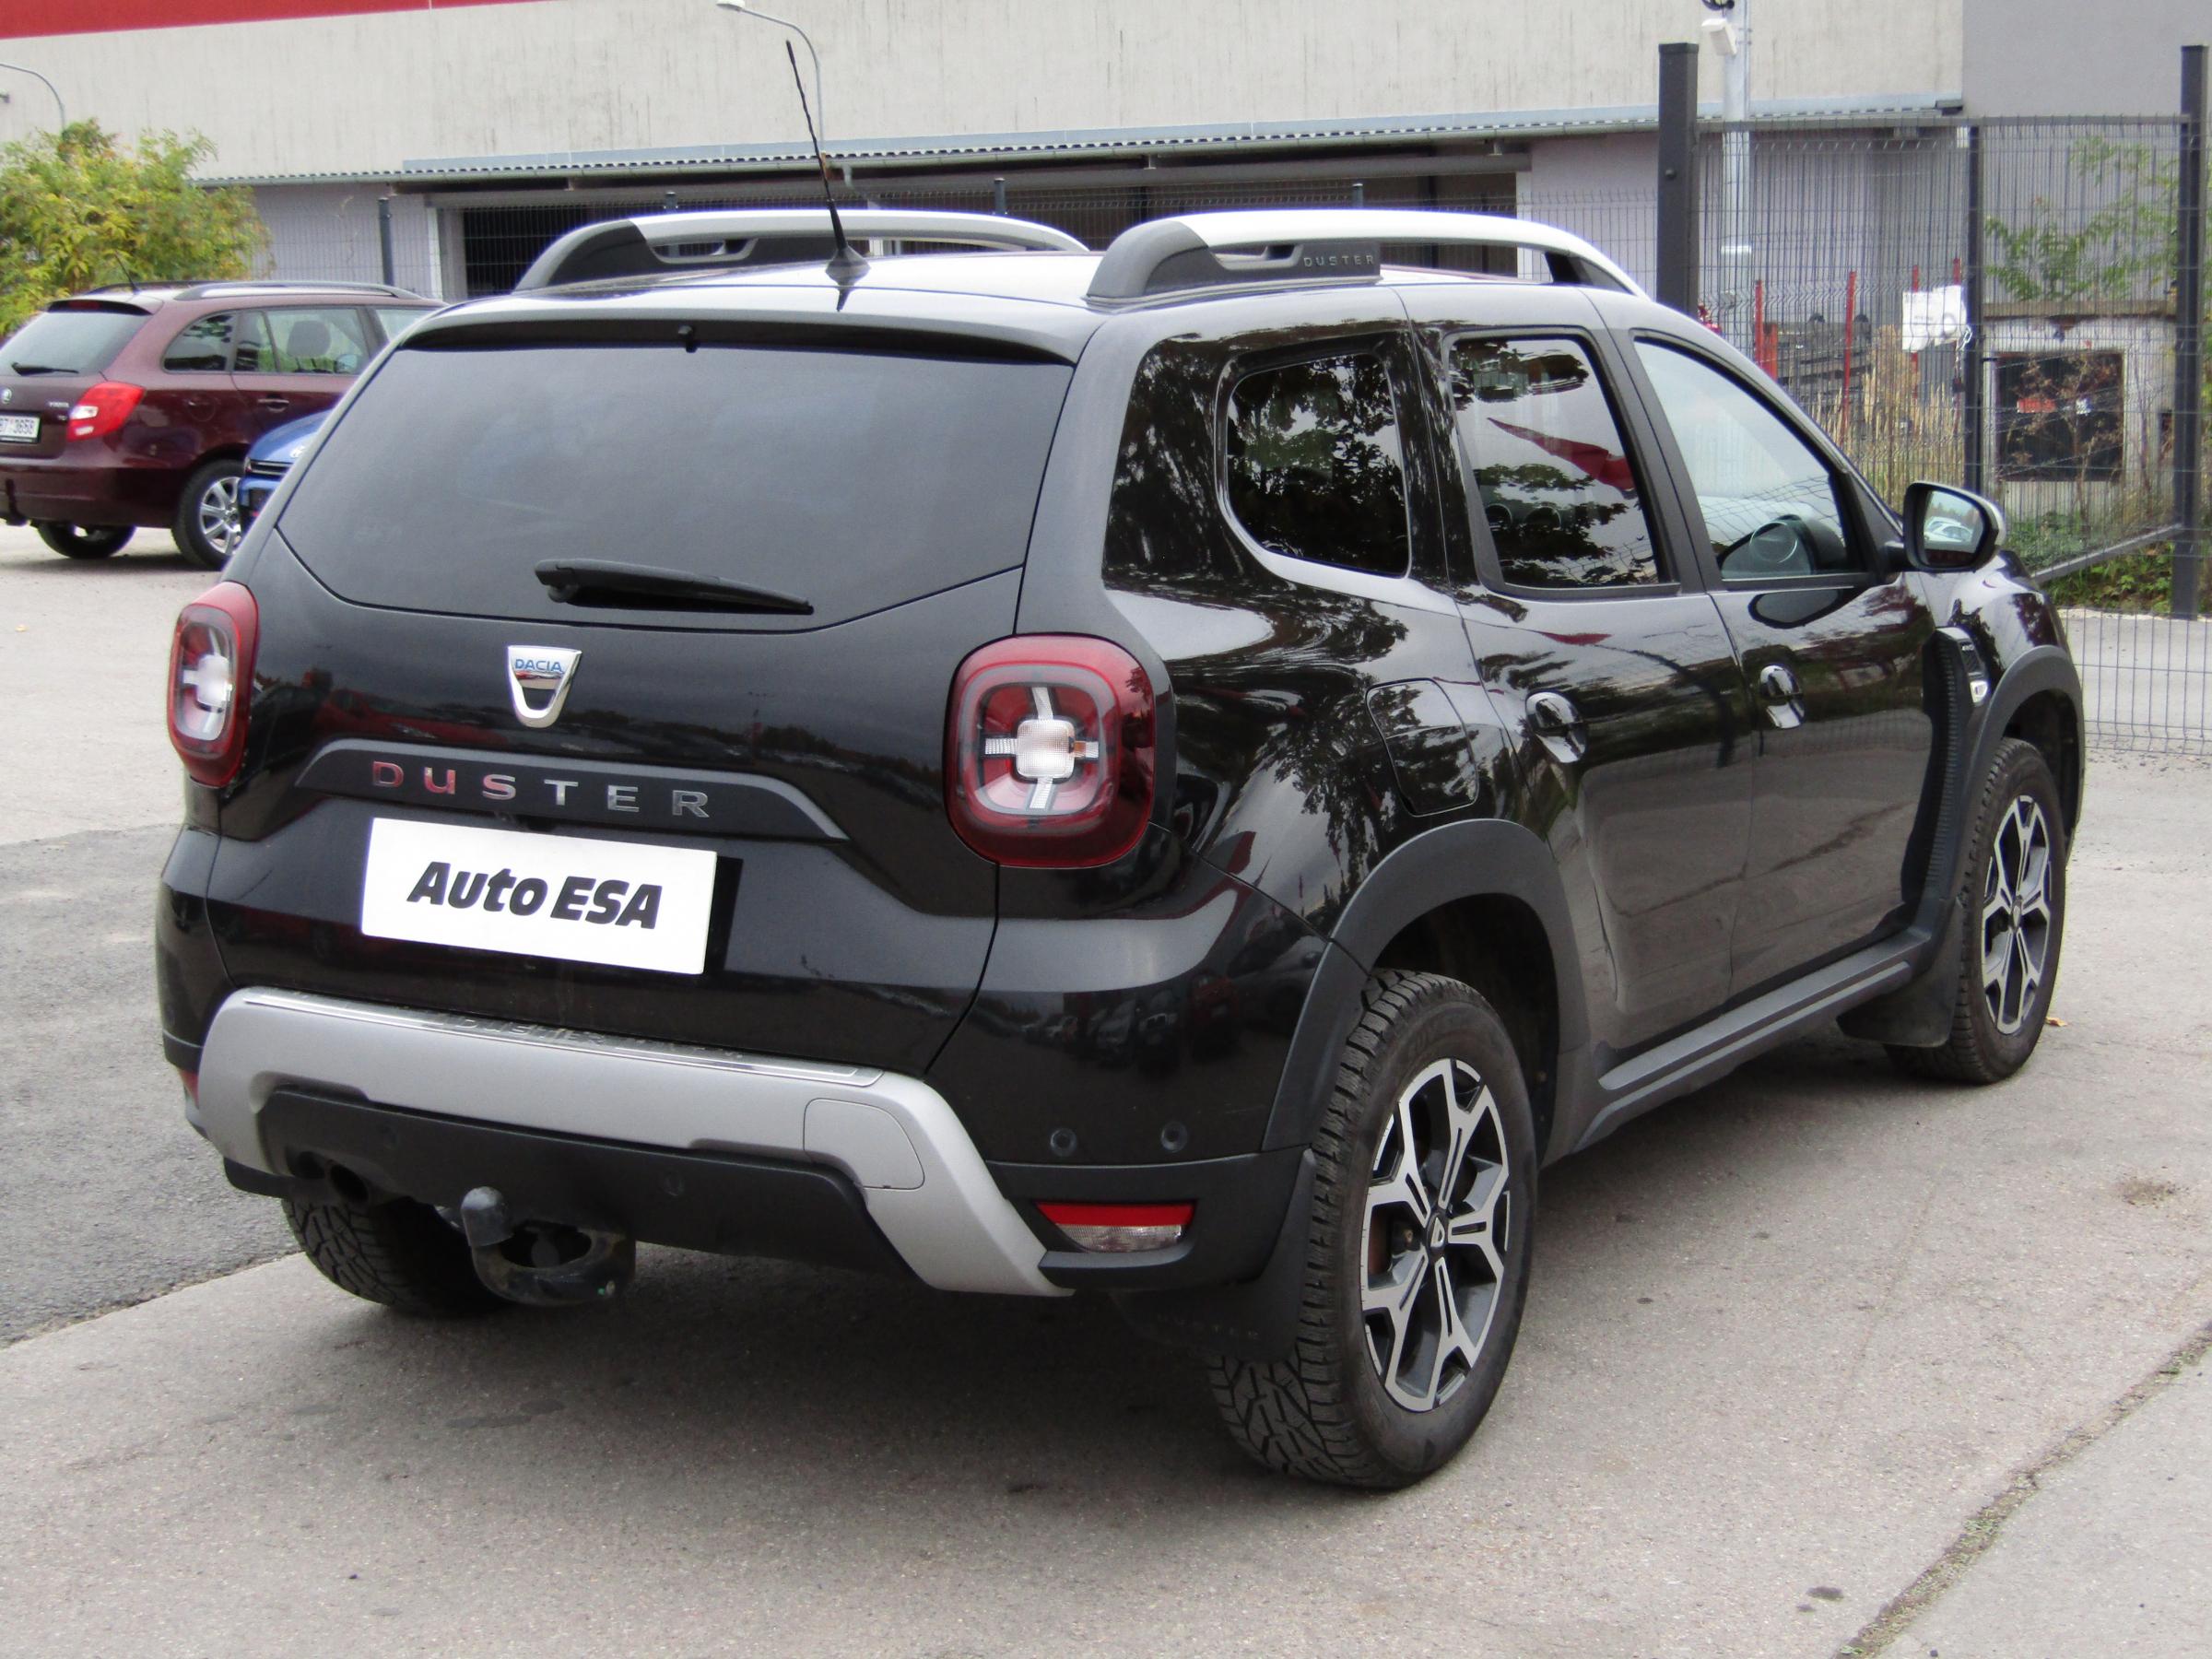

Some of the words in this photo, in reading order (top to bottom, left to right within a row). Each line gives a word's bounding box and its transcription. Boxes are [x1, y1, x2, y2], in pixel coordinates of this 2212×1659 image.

[1303, 254, 1374, 267] DUSTER
[514, 658, 562, 672] DACIA
[372, 760, 710, 818] DUSTER
[406, 861, 548, 916] Auto
[550, 876, 663, 930] ESA
